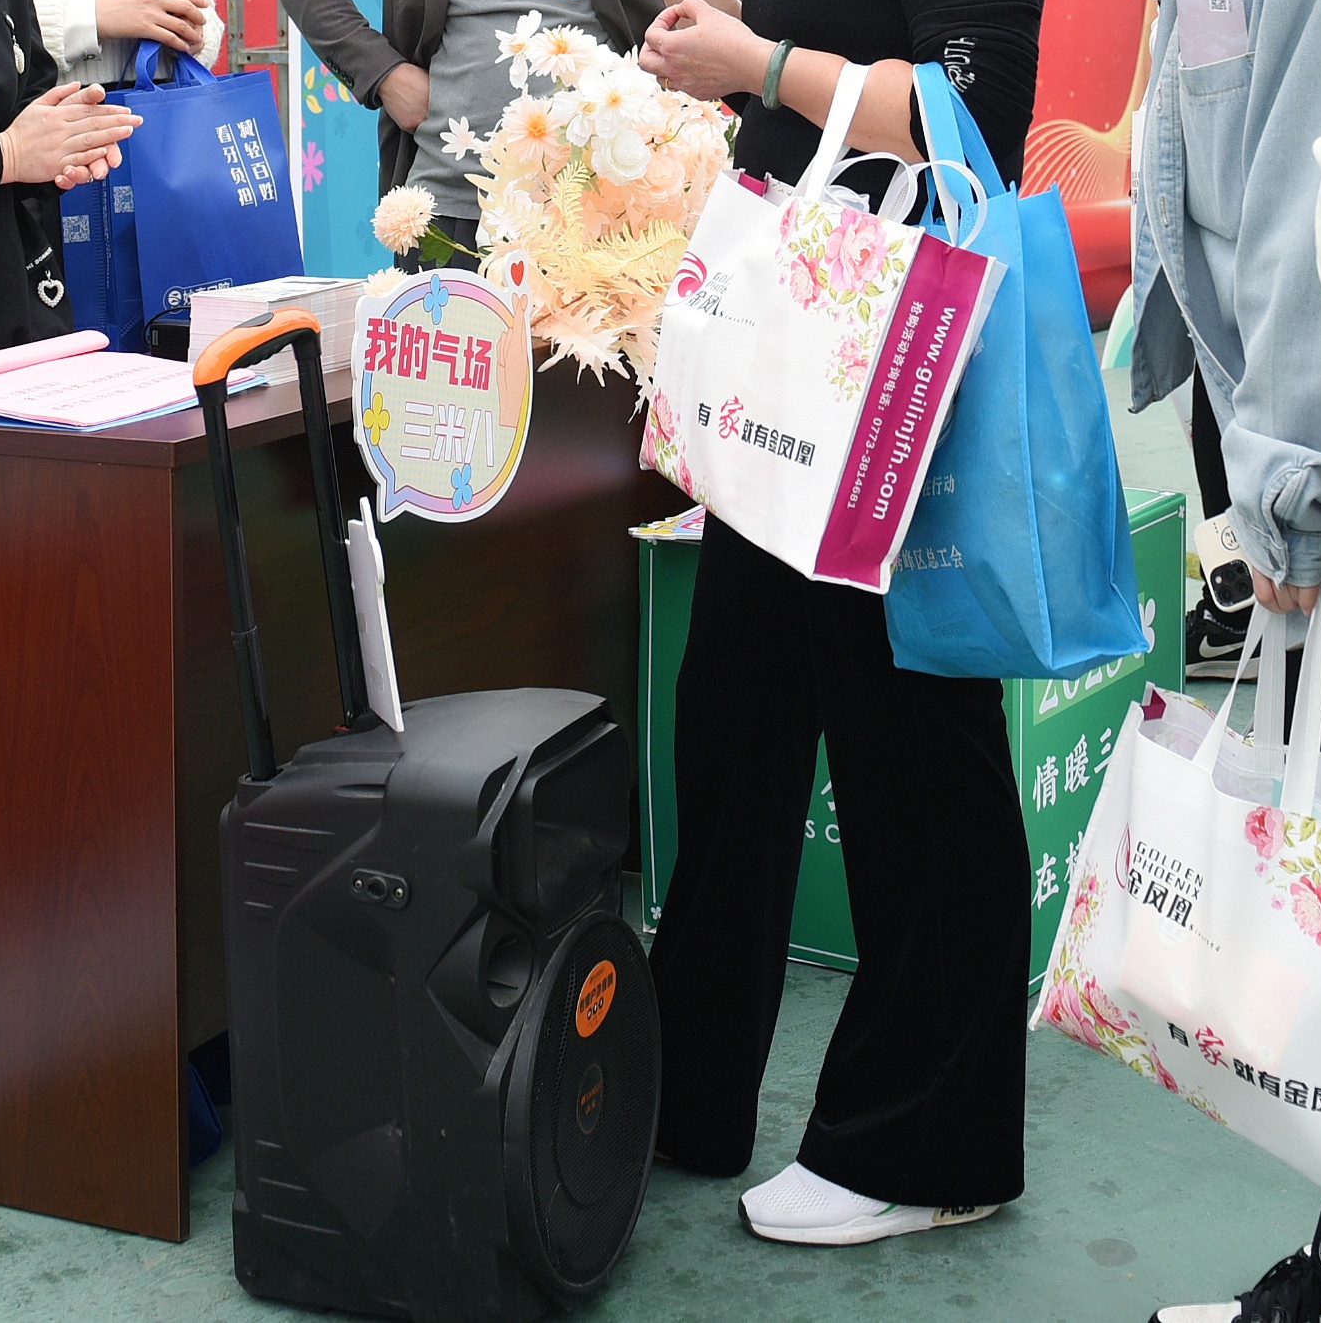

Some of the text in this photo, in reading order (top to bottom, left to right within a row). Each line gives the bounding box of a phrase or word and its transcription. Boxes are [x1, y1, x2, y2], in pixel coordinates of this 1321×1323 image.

[215, 124, 254, 207] 看牙负担
[236, 118, 275, 202] 减轻百姓
[364, 317, 493, 391] 我的气场
[400, 401, 494, 468] 三米八
[872, 306, 956, 520] www.guilinjfh.com
[1127, 868, 1193, 928] 金凤凰
[1133, 853, 1200, 901] PHOENIX
